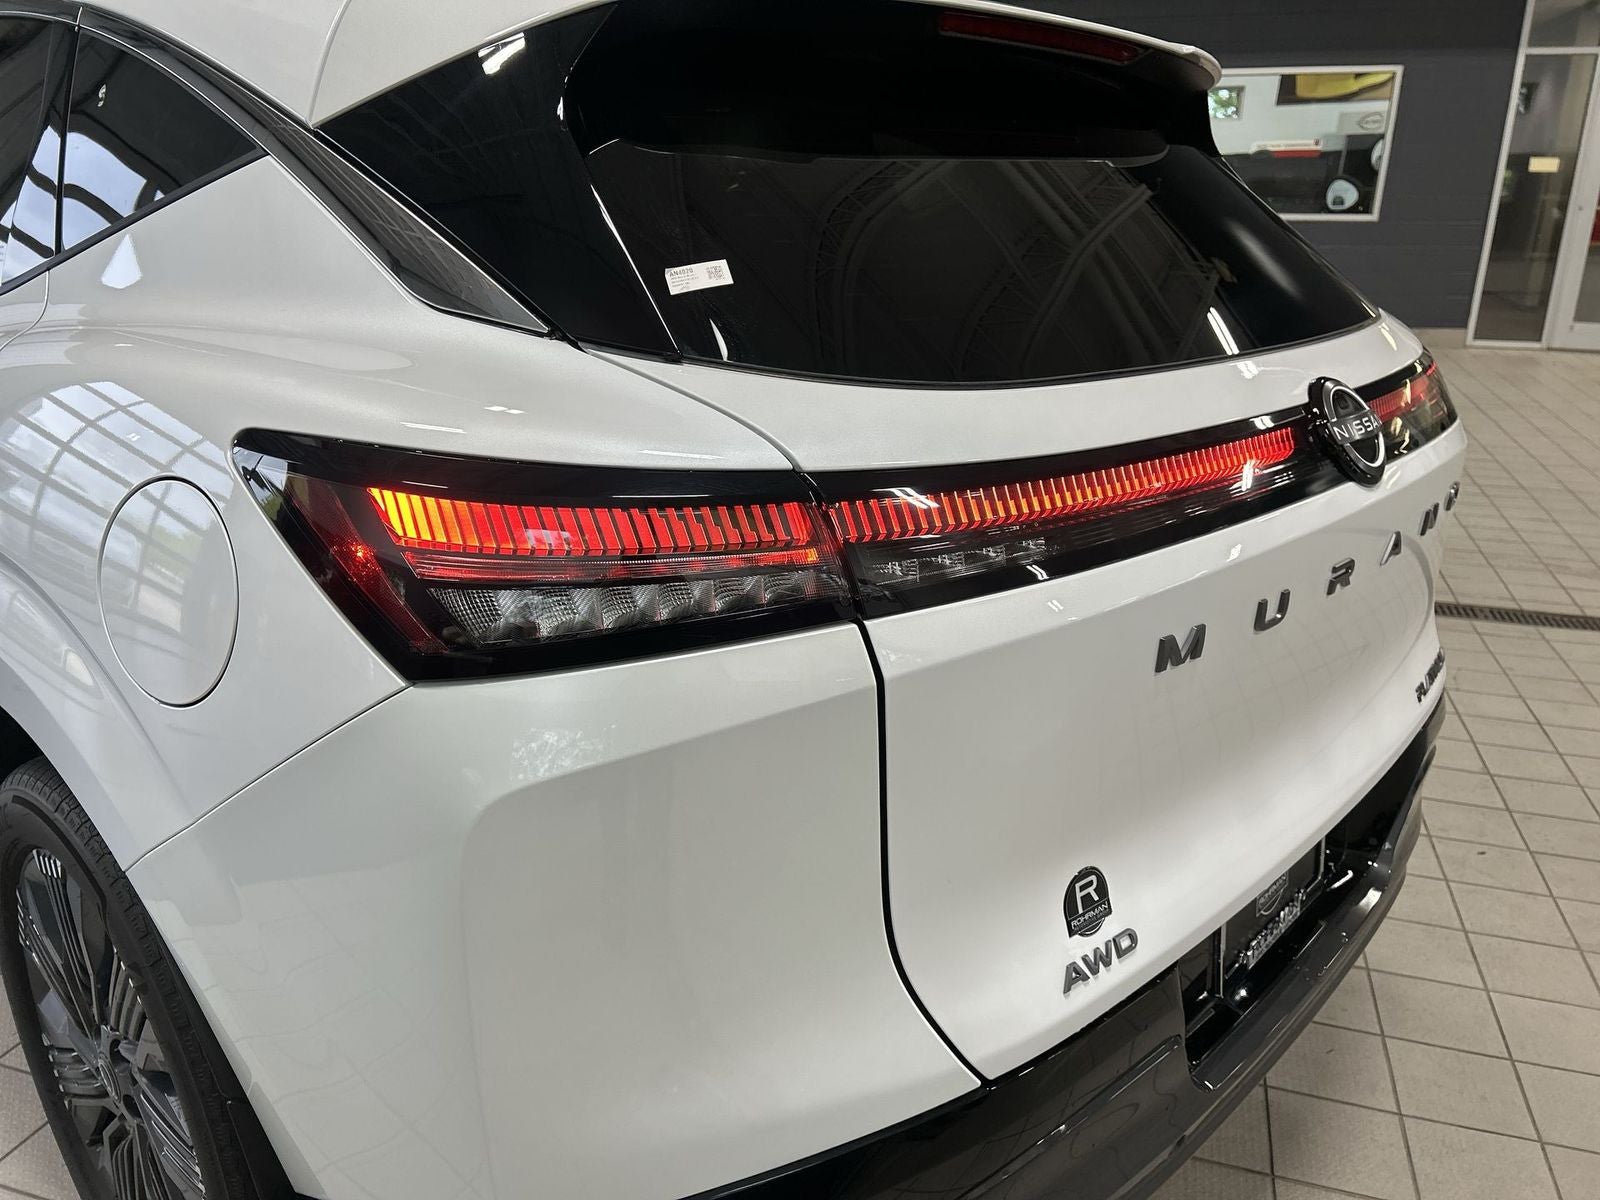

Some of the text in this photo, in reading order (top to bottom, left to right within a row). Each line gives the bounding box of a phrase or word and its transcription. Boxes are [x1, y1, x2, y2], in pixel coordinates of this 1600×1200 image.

[1333, 415, 1381, 440] NISSA
[1155, 478, 1459, 673] MURANO
[1075, 875, 1099, 914] R
[1071, 901, 1109, 930] ROHRMAN
[1063, 928, 1138, 994] AWD
